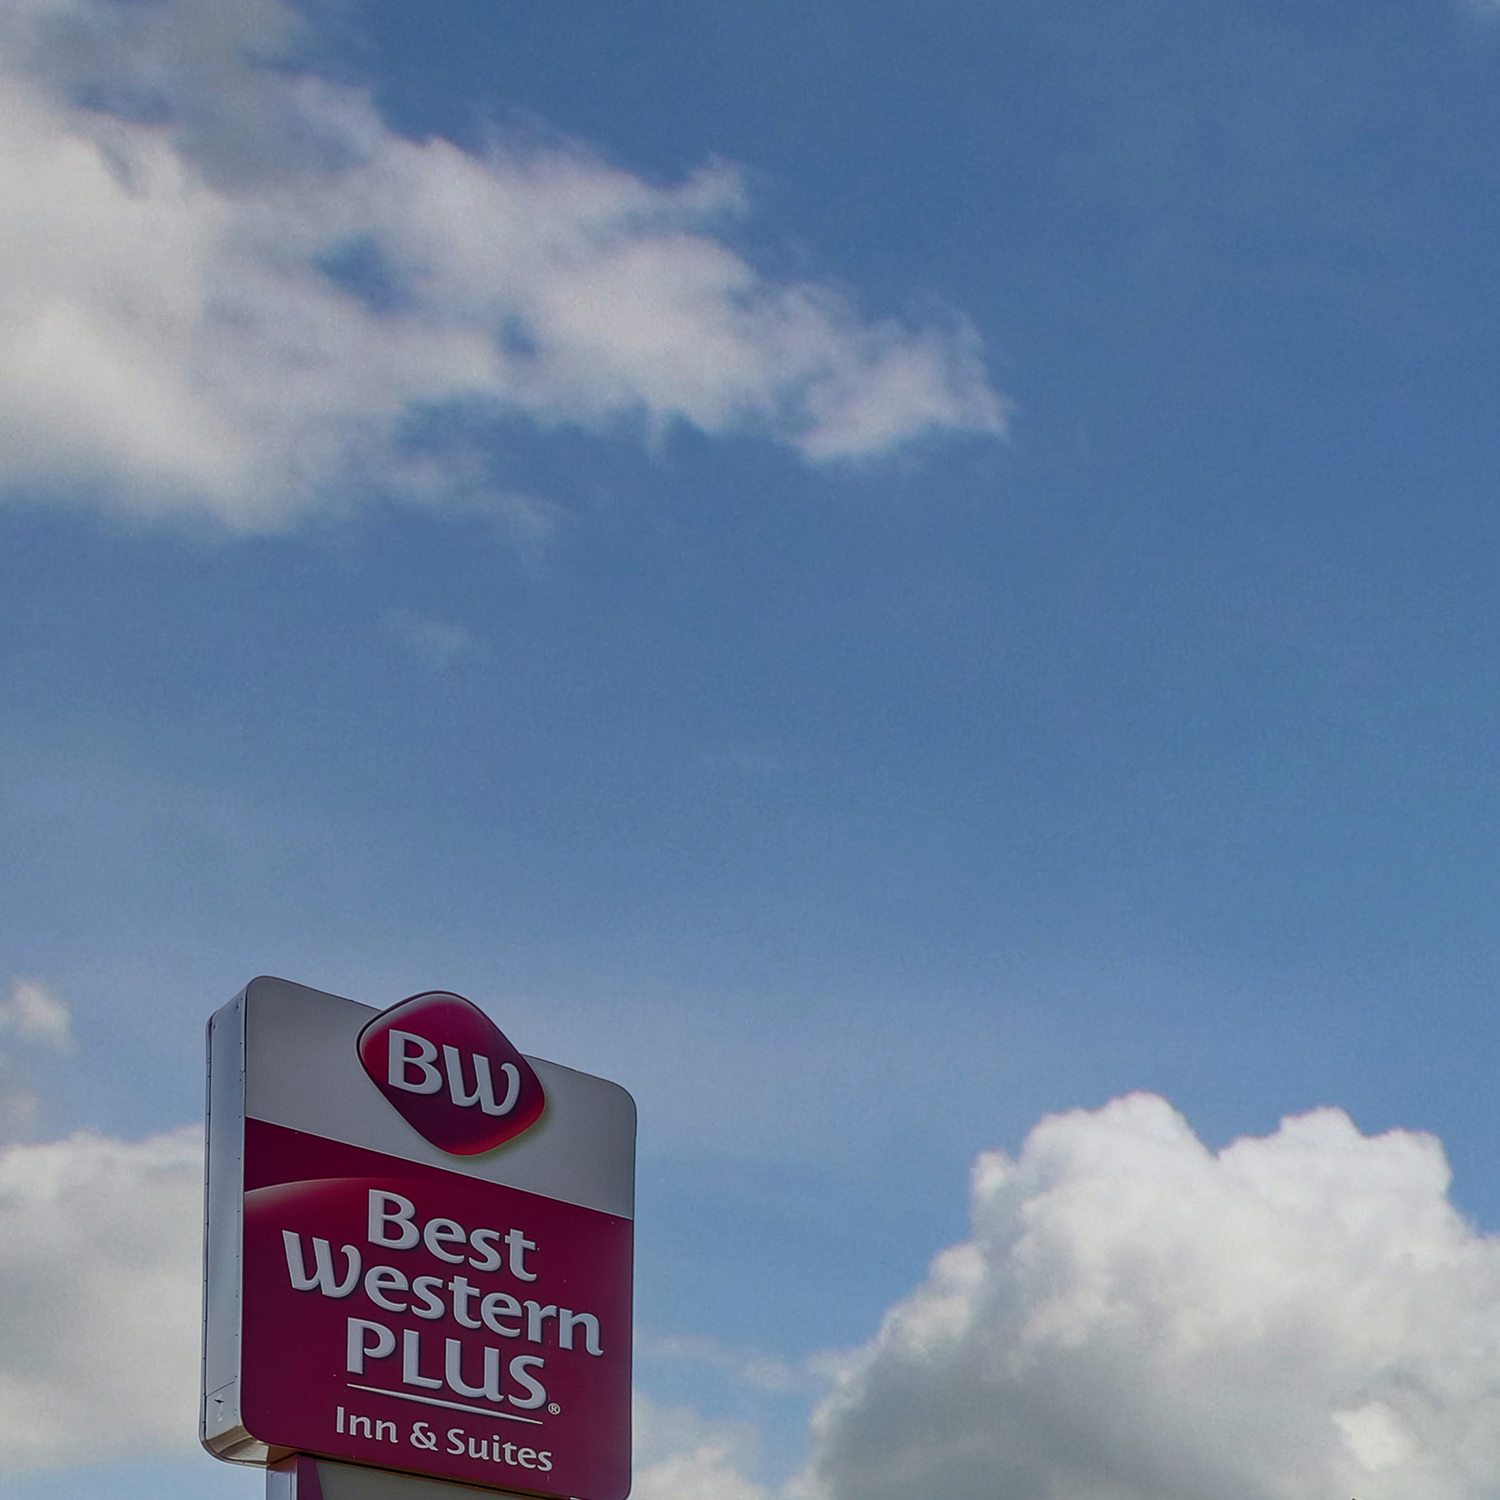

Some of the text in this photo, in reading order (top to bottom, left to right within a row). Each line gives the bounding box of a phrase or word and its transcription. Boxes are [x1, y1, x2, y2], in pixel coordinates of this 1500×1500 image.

[388, 1029, 520, 1116] BW
[368, 1188, 537, 1281] Best
[282, 1230, 603, 1355] Western
[336, 1406, 553, 1472] Inn & Suites
